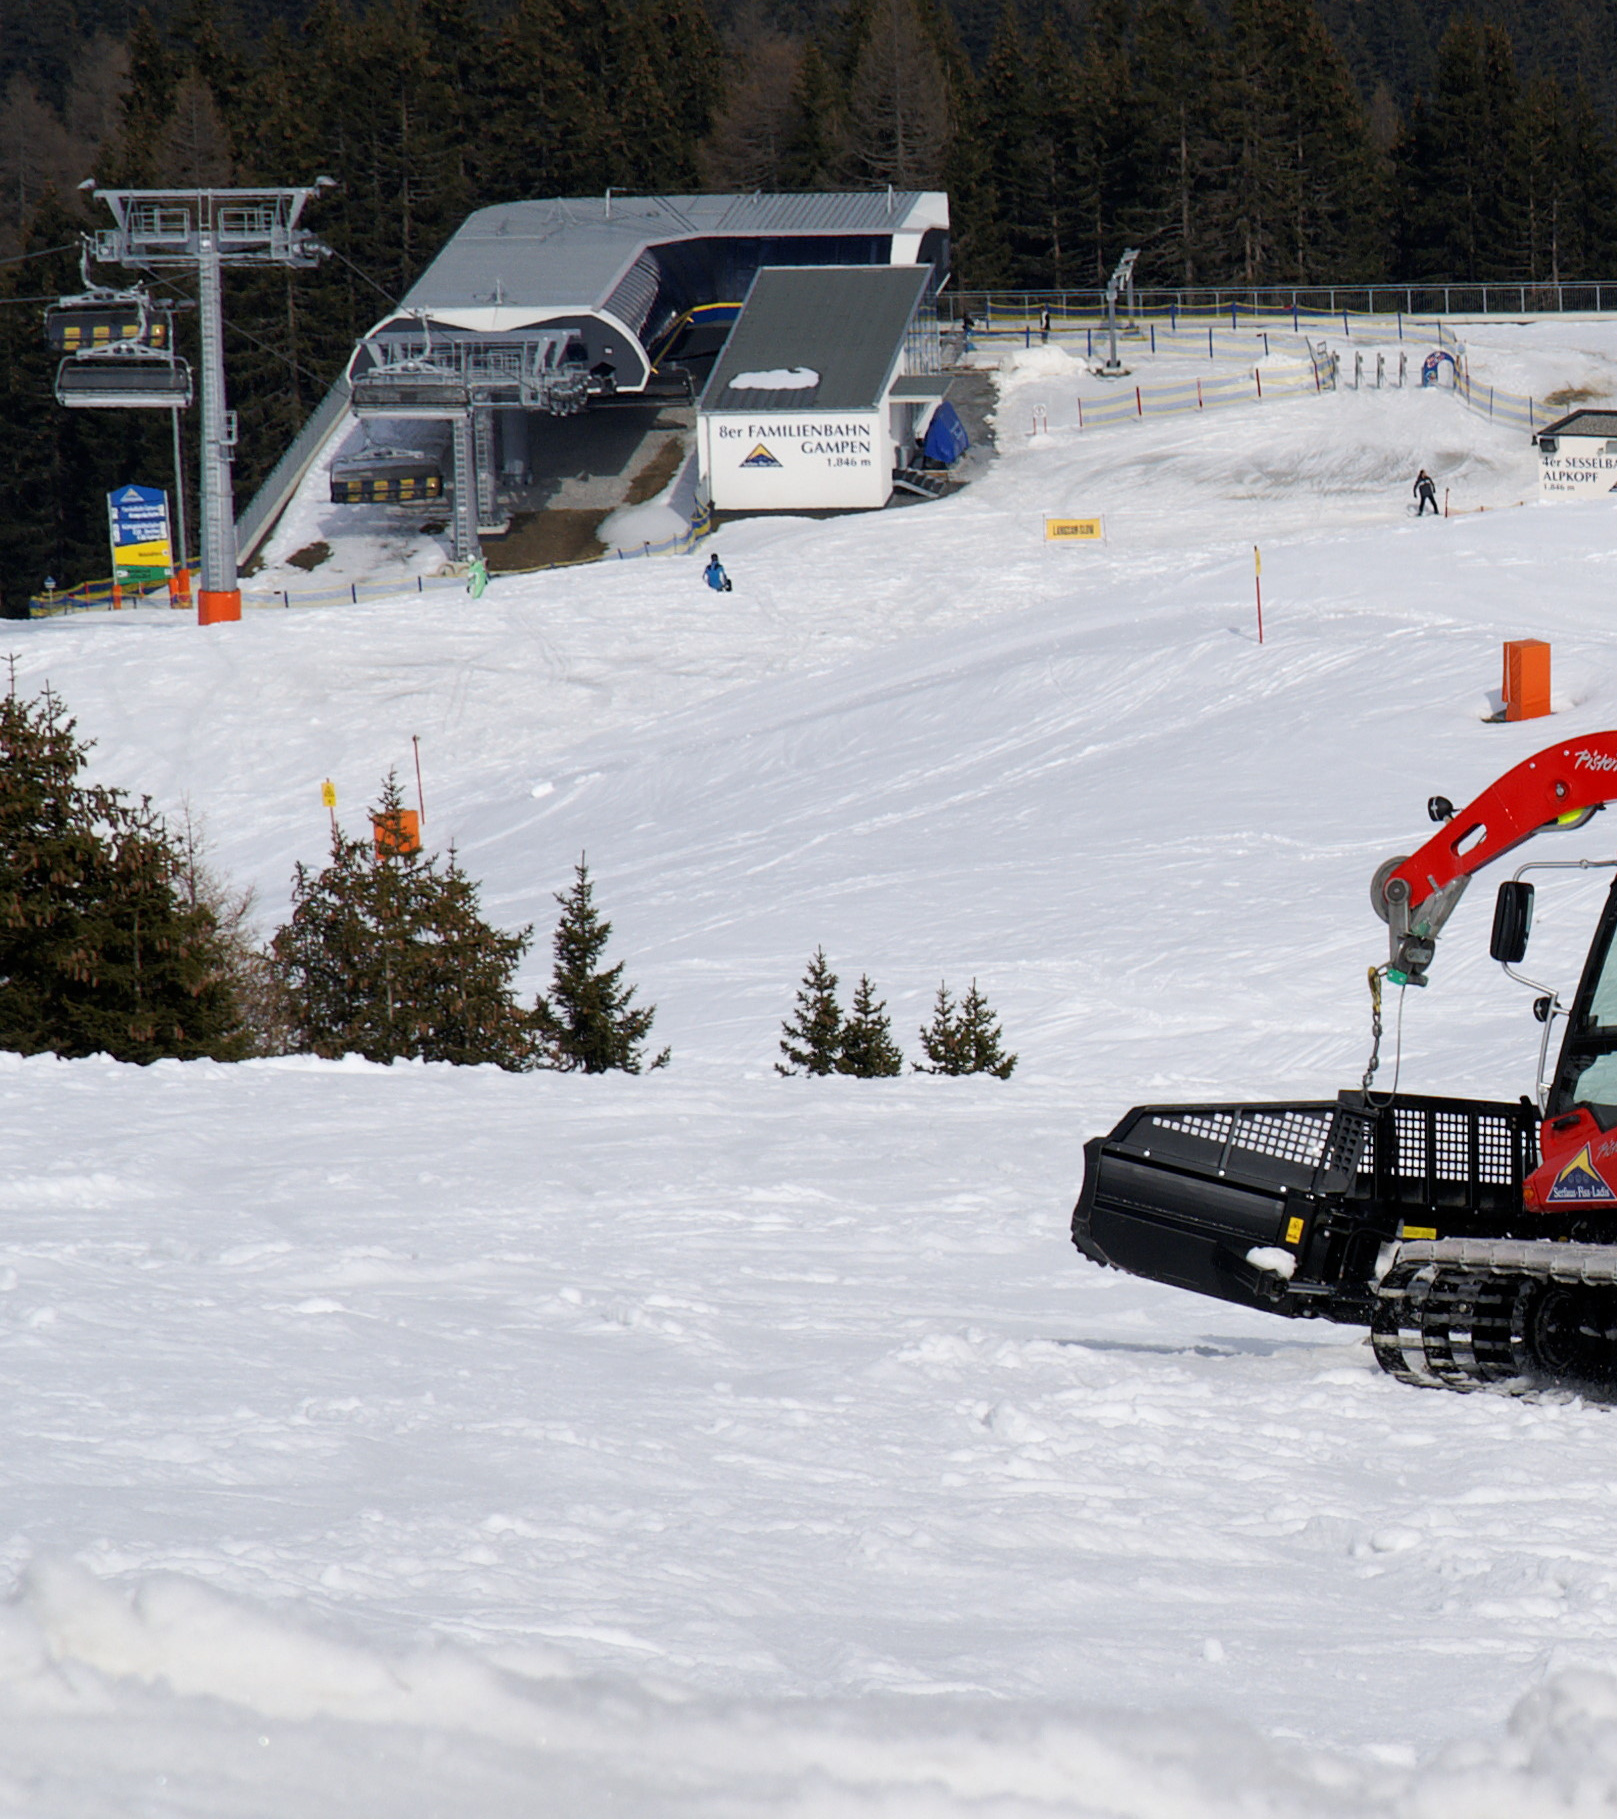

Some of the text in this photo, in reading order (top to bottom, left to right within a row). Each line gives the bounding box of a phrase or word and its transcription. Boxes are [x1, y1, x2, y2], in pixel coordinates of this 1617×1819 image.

[719, 424, 870, 439] 8er FAMILIENBAHN
[801, 441, 871, 454] GAMPEN
[827, 457, 857, 467] 1.846
[1541, 456, 1562, 469] 4er
[1543, 471, 1598, 483] ALPKOPF
